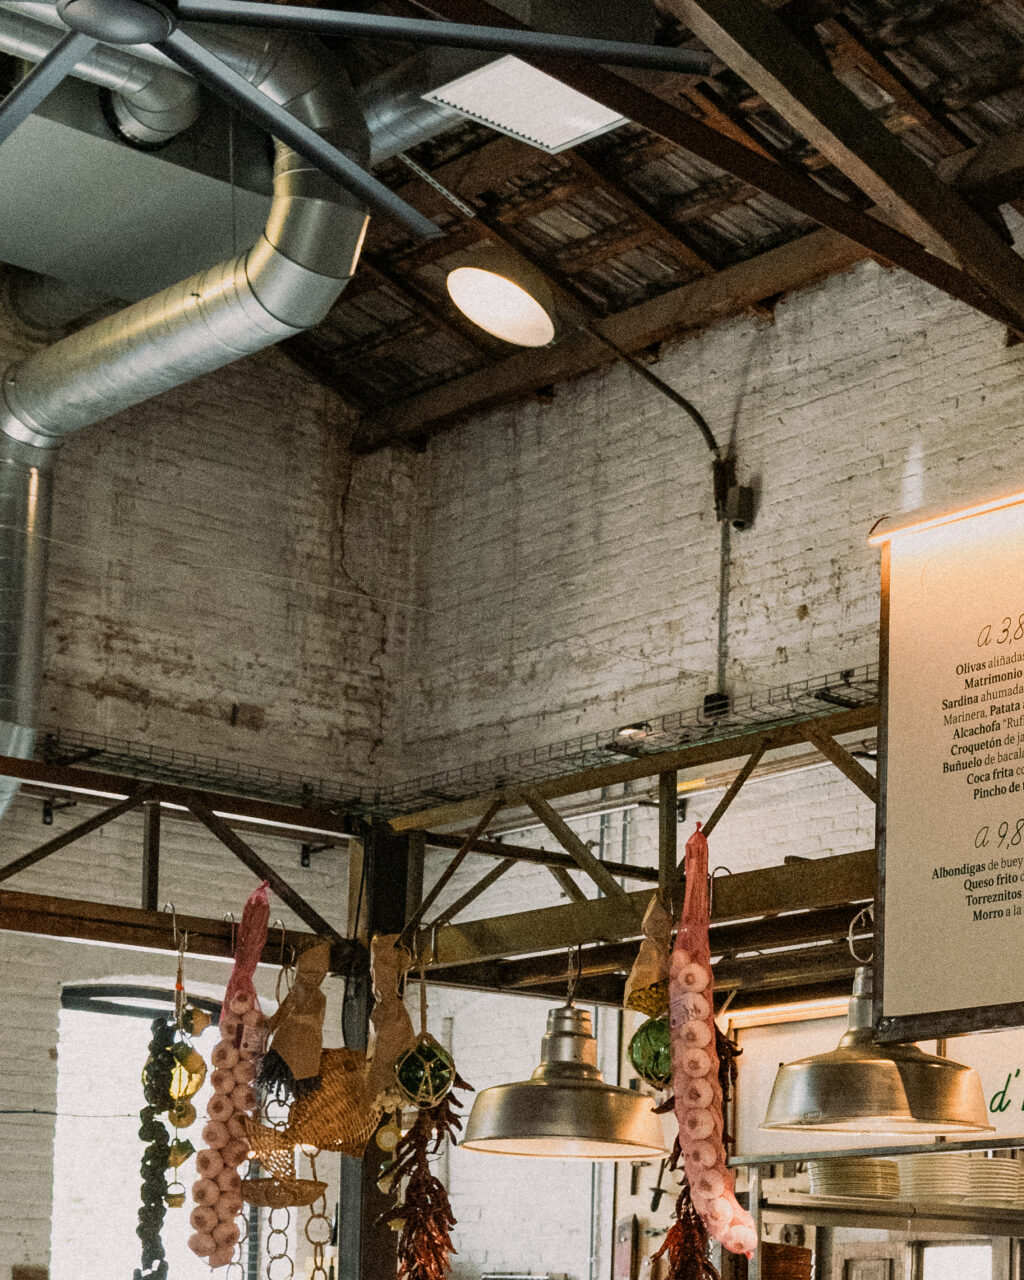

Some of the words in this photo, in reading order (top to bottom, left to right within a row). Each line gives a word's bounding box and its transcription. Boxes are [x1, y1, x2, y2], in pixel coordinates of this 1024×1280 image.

[977, 625, 992, 647] a
[955, 662, 986, 675] Olivas
[964, 668, 1023, 690] Matrimonio
[942, 695, 979, 710] Sardina
[981, 684, 1024, 702] ahumada
[990, 702, 1020, 716] Patata
[953, 720, 1001, 740] Alcachofa
[950, 737, 1002, 756] Croquetón
[1004, 734, 1015, 745] de
[943, 757, 982, 774] Buñuelo
[984, 754, 995, 765] de
[966, 773, 990, 785] Coca
[992, 767, 1014, 780] frita
[973, 785, 1007, 800] Pincho
[1008, 781, 1020, 793] de
[974, 826, 989, 848] a
[932, 863, 986, 880] Albondigas
[988, 859, 999, 870] de
[1001, 858, 1023, 868] buey
[964, 878, 994, 892] Queso
[996, 873, 1018, 885] frito
[965, 890, 1022, 906] Torreznitos
[973, 909, 1004, 921] Morro
[1006, 908, 1011, 917] a
[1013, 905, 1022, 916] la
